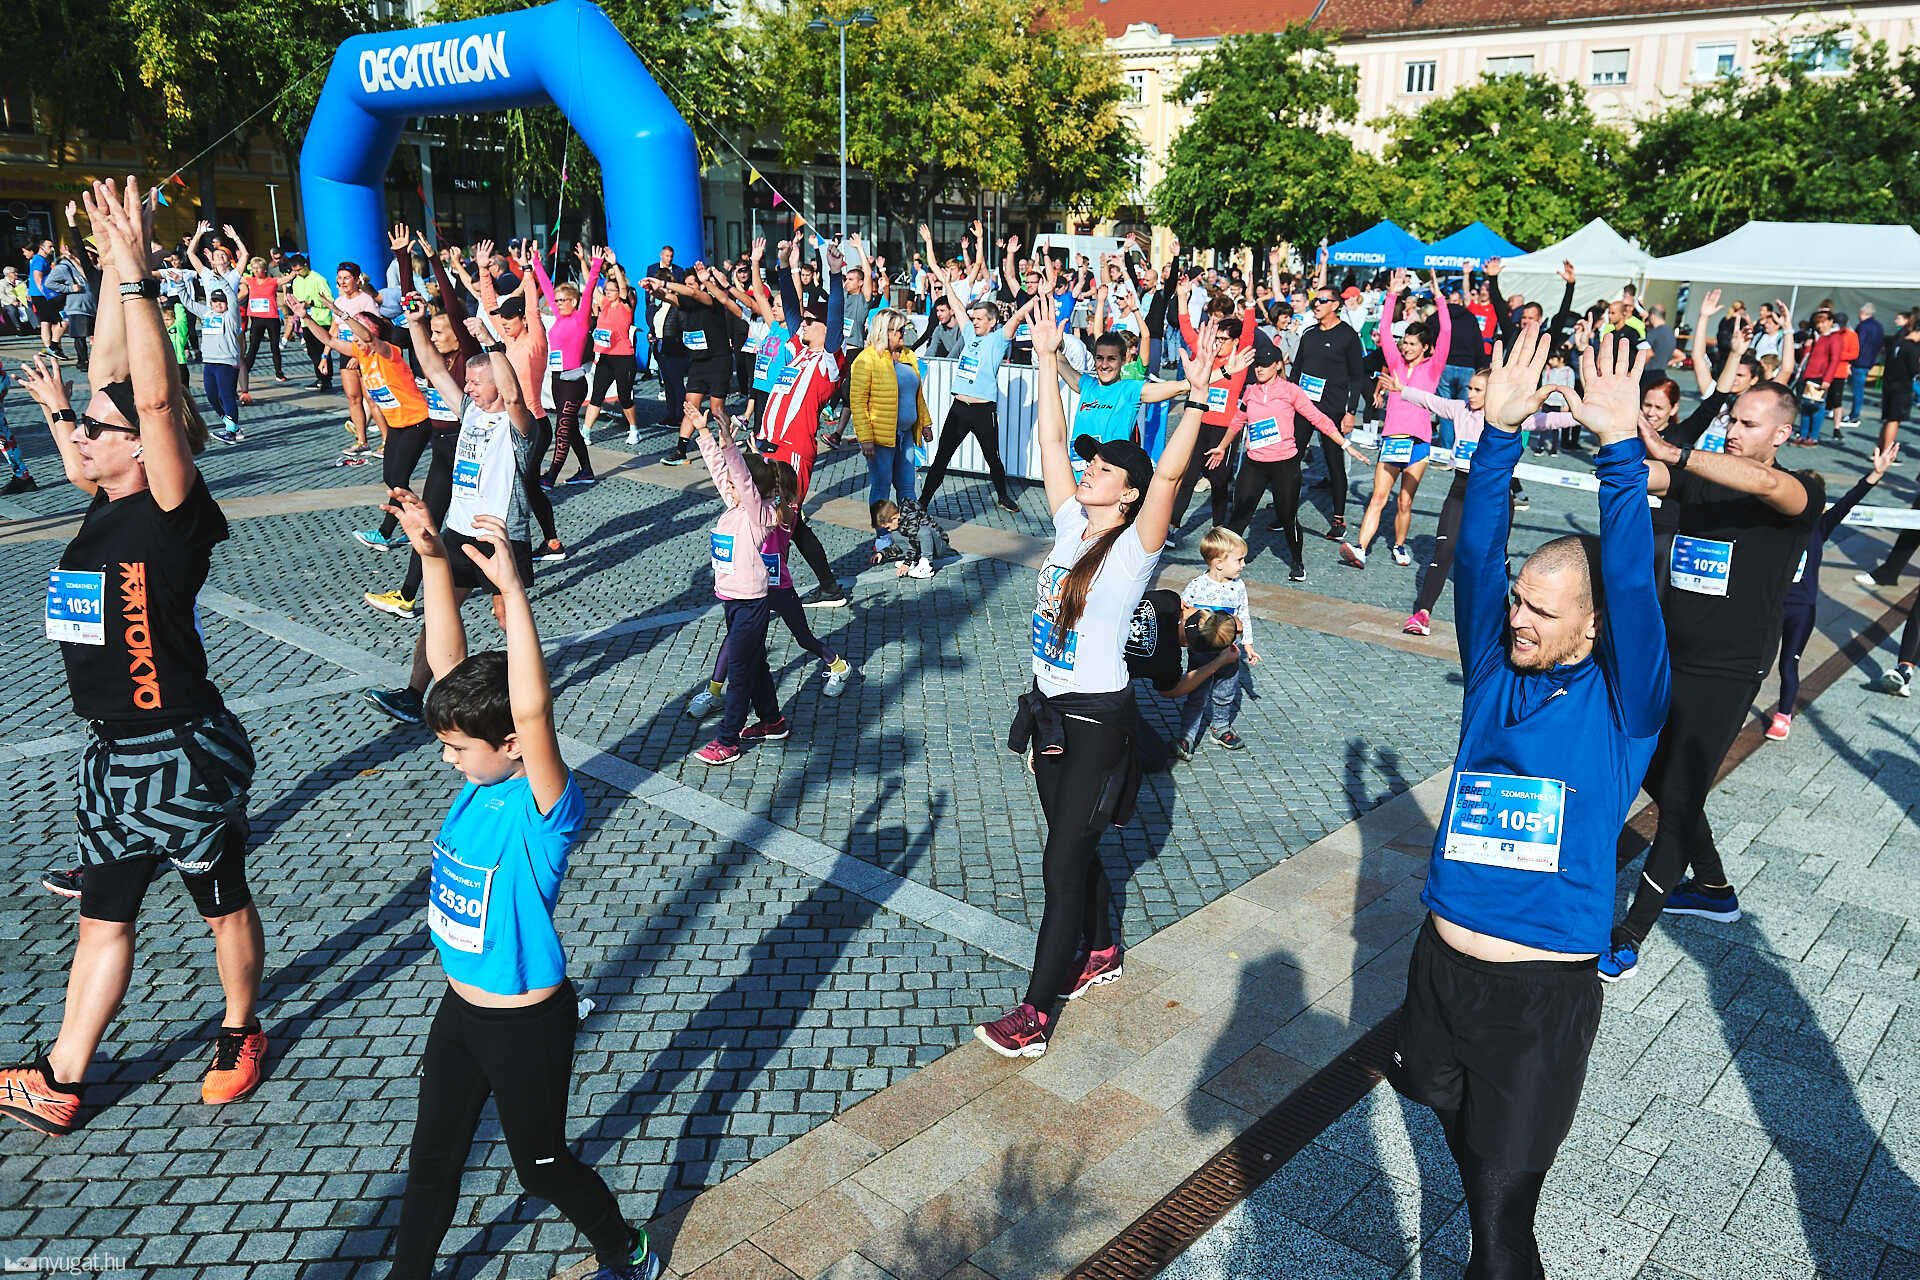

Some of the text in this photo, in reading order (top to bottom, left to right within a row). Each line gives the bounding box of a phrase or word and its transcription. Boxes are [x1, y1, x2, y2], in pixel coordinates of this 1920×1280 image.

[359, 31, 510, 93] DECATHLON
[1334, 252, 1386, 264] DECATHLON
[1424, 255, 1481, 268] DECATHLON
[1693, 558, 1728, 574] 1079
[66, 597, 100, 615] 1031
[122, 610, 162, 710] TOKYO
[1497, 809, 1556, 834] 1051
[438, 883, 482, 918] 2530
